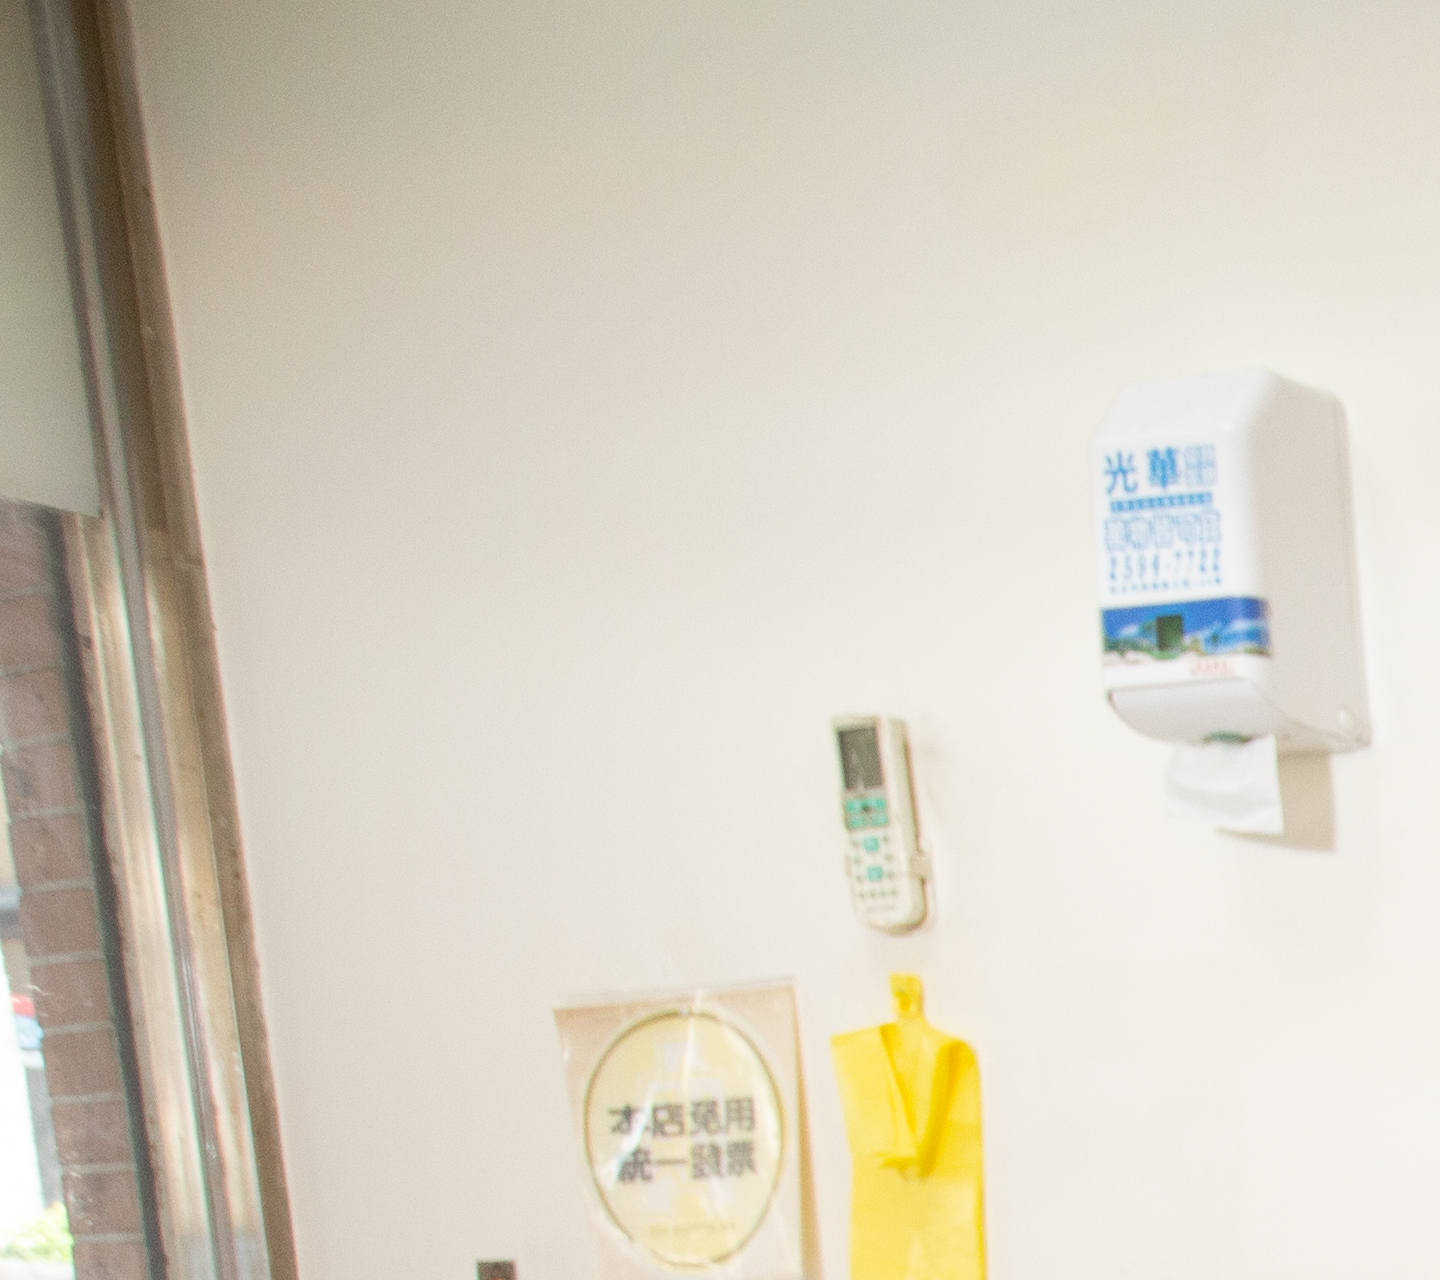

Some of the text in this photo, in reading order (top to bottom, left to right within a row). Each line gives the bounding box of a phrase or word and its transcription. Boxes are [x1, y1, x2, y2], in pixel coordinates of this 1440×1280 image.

[608, 1096, 757, 1141] 本店免用
[616, 1140, 758, 1184] 統一發票
